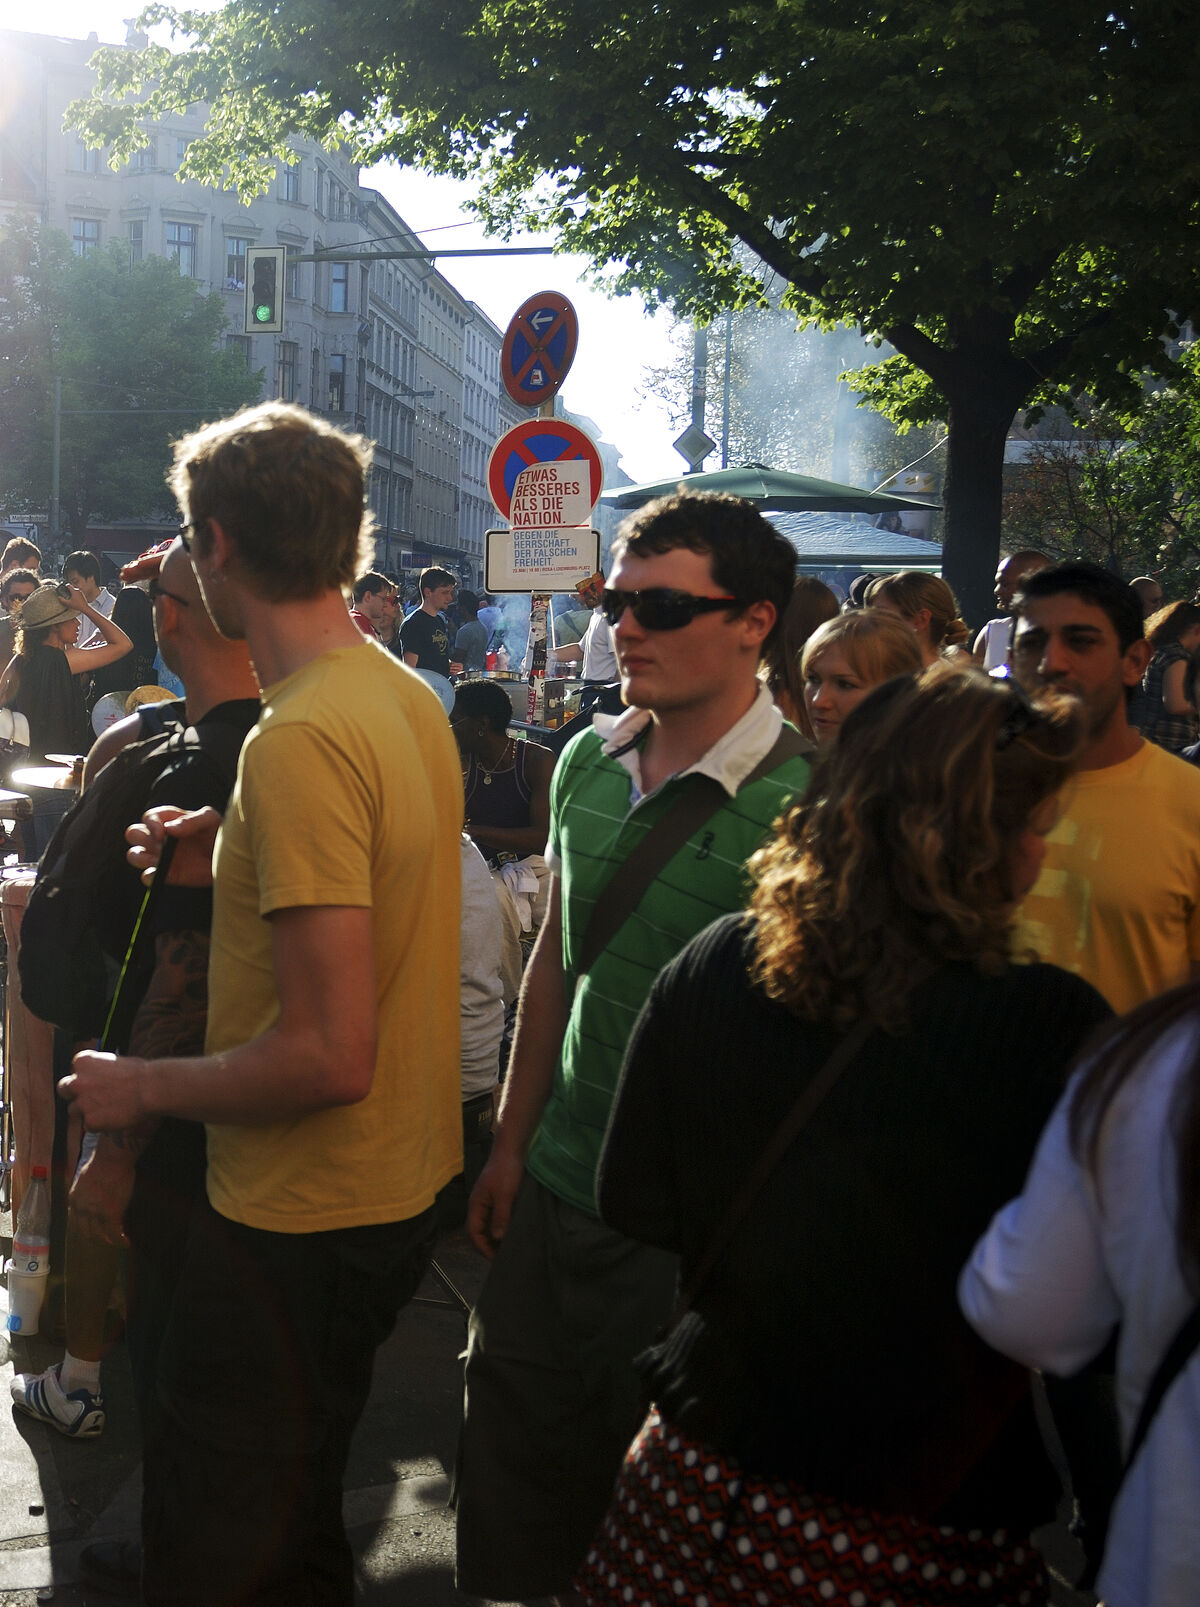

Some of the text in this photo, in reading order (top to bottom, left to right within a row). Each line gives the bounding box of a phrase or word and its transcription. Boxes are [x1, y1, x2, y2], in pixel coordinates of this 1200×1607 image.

[518, 468, 558, 485] ETWAS
[515, 481, 580, 498] BESSERES
[513, 497, 564, 512] ALS DIE
[513, 511, 566, 526] NATION.
[513, 530, 559, 541] GEGEN DIE
[513, 538, 570, 550] HERRSCHAFT
[514, 547, 577, 559] DER FALSCHEN
[514, 557, 555, 567] FREIHEIT.
